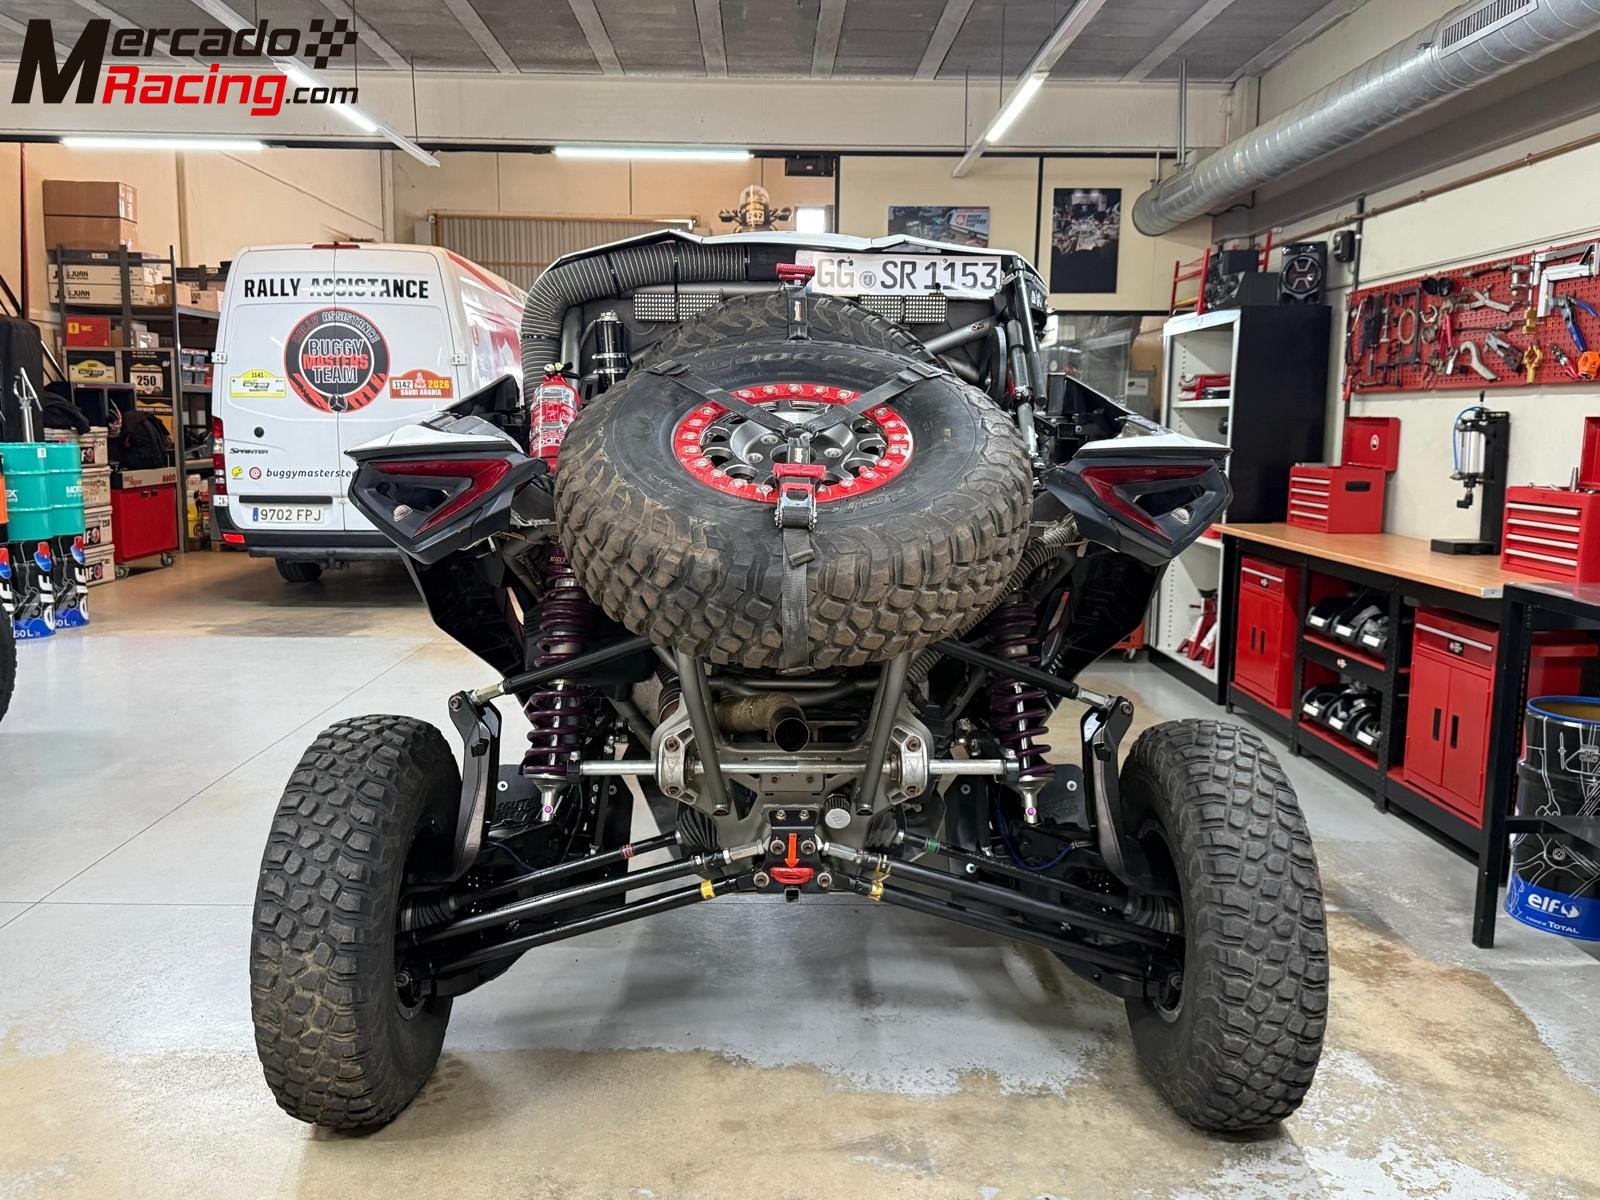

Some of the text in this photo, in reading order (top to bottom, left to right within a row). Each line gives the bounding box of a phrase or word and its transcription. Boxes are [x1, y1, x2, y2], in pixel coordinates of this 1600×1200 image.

[817, 259, 854, 288] GG
[881, 261, 917, 290] SR
[924, 262, 998, 290] 1153
[244, 278, 429, 299] RALLY ASSISTANCE
[322, 311, 381, 344] ASSISTANCE
[308, 339, 365, 357] BUGGY
[303, 354, 369, 370] MASTERS
[136, 375, 157, 386] 250
[312, 366, 358, 384] TEAM
[260, 509, 321, 522] 9702 FPJ
